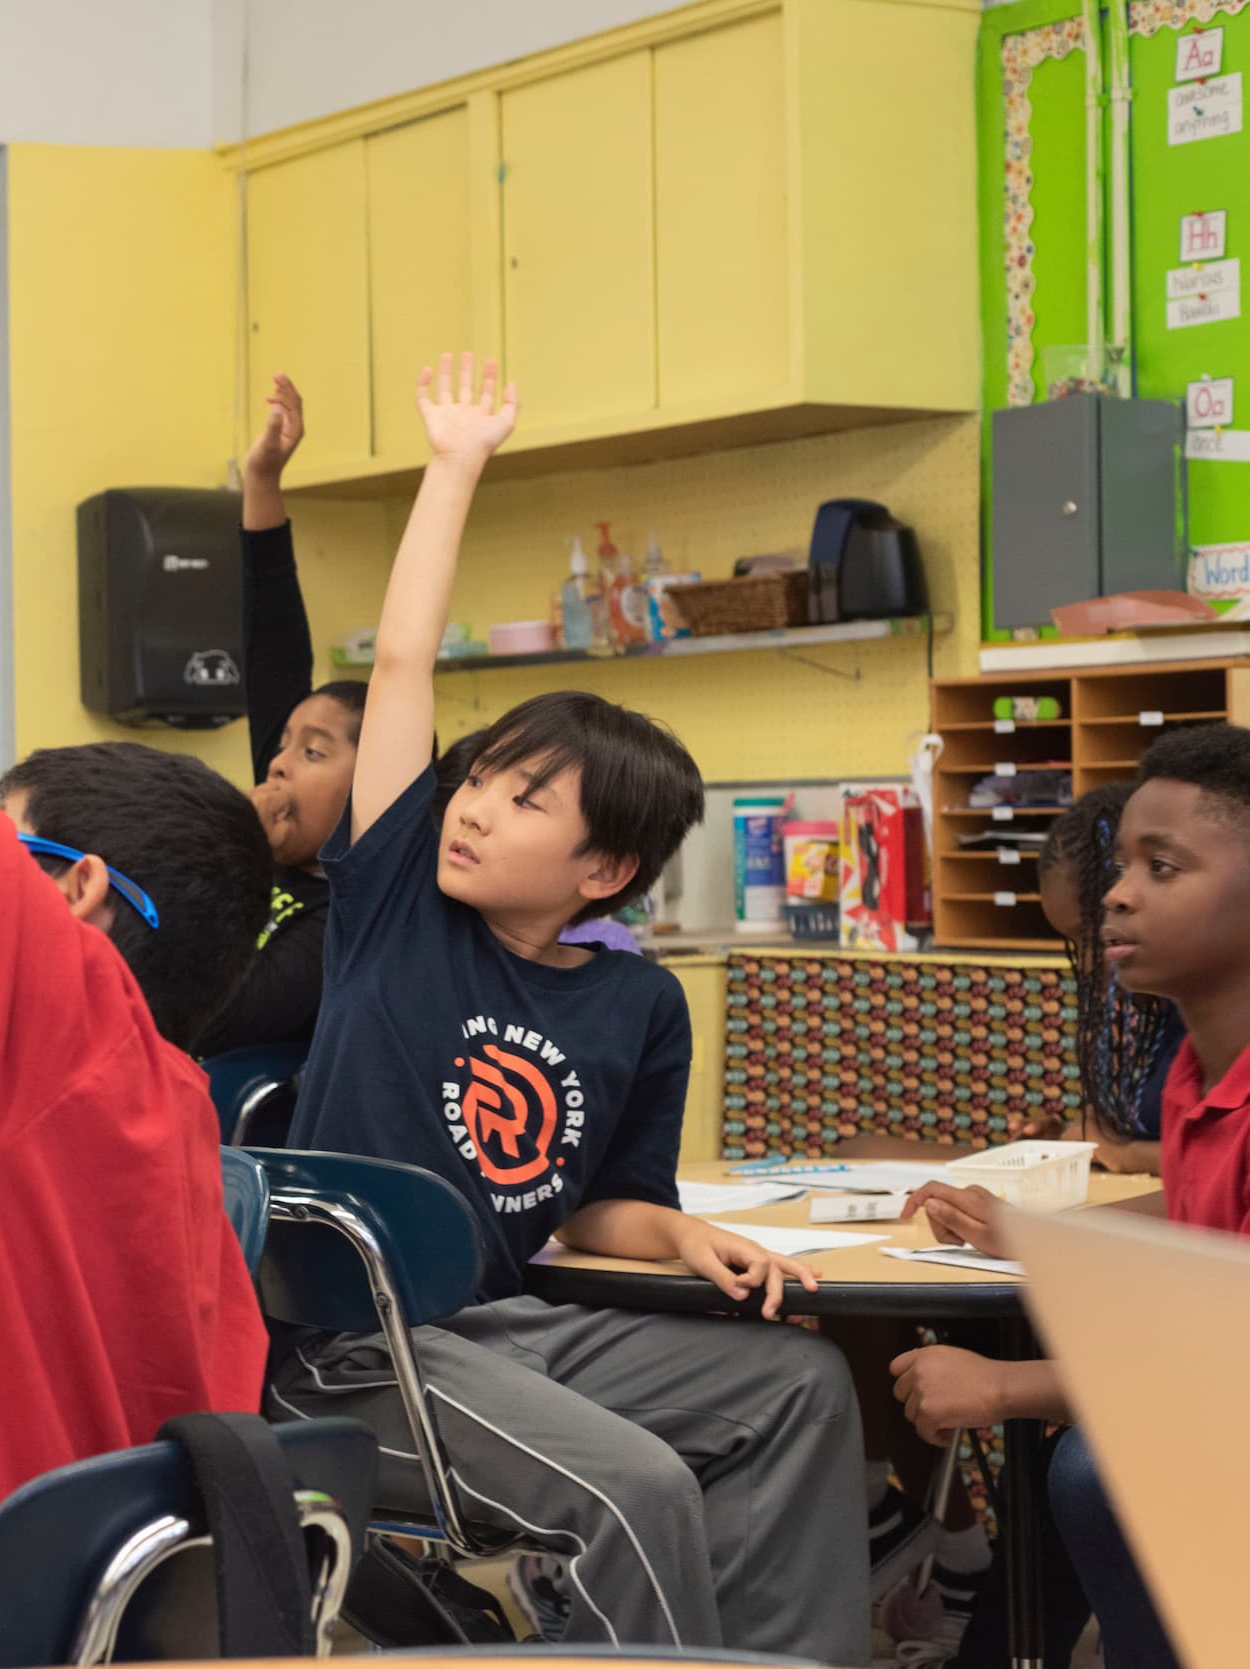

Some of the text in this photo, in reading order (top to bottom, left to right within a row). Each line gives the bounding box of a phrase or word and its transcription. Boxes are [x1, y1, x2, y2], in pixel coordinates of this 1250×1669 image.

[1183, 39, 1214, 71] Aa
[1188, 219, 1218, 251] Hh
[503, 1024, 566, 1067] NEW
[560, 1069, 585, 1148] YORK
[442, 1082, 478, 1161] ROAD
